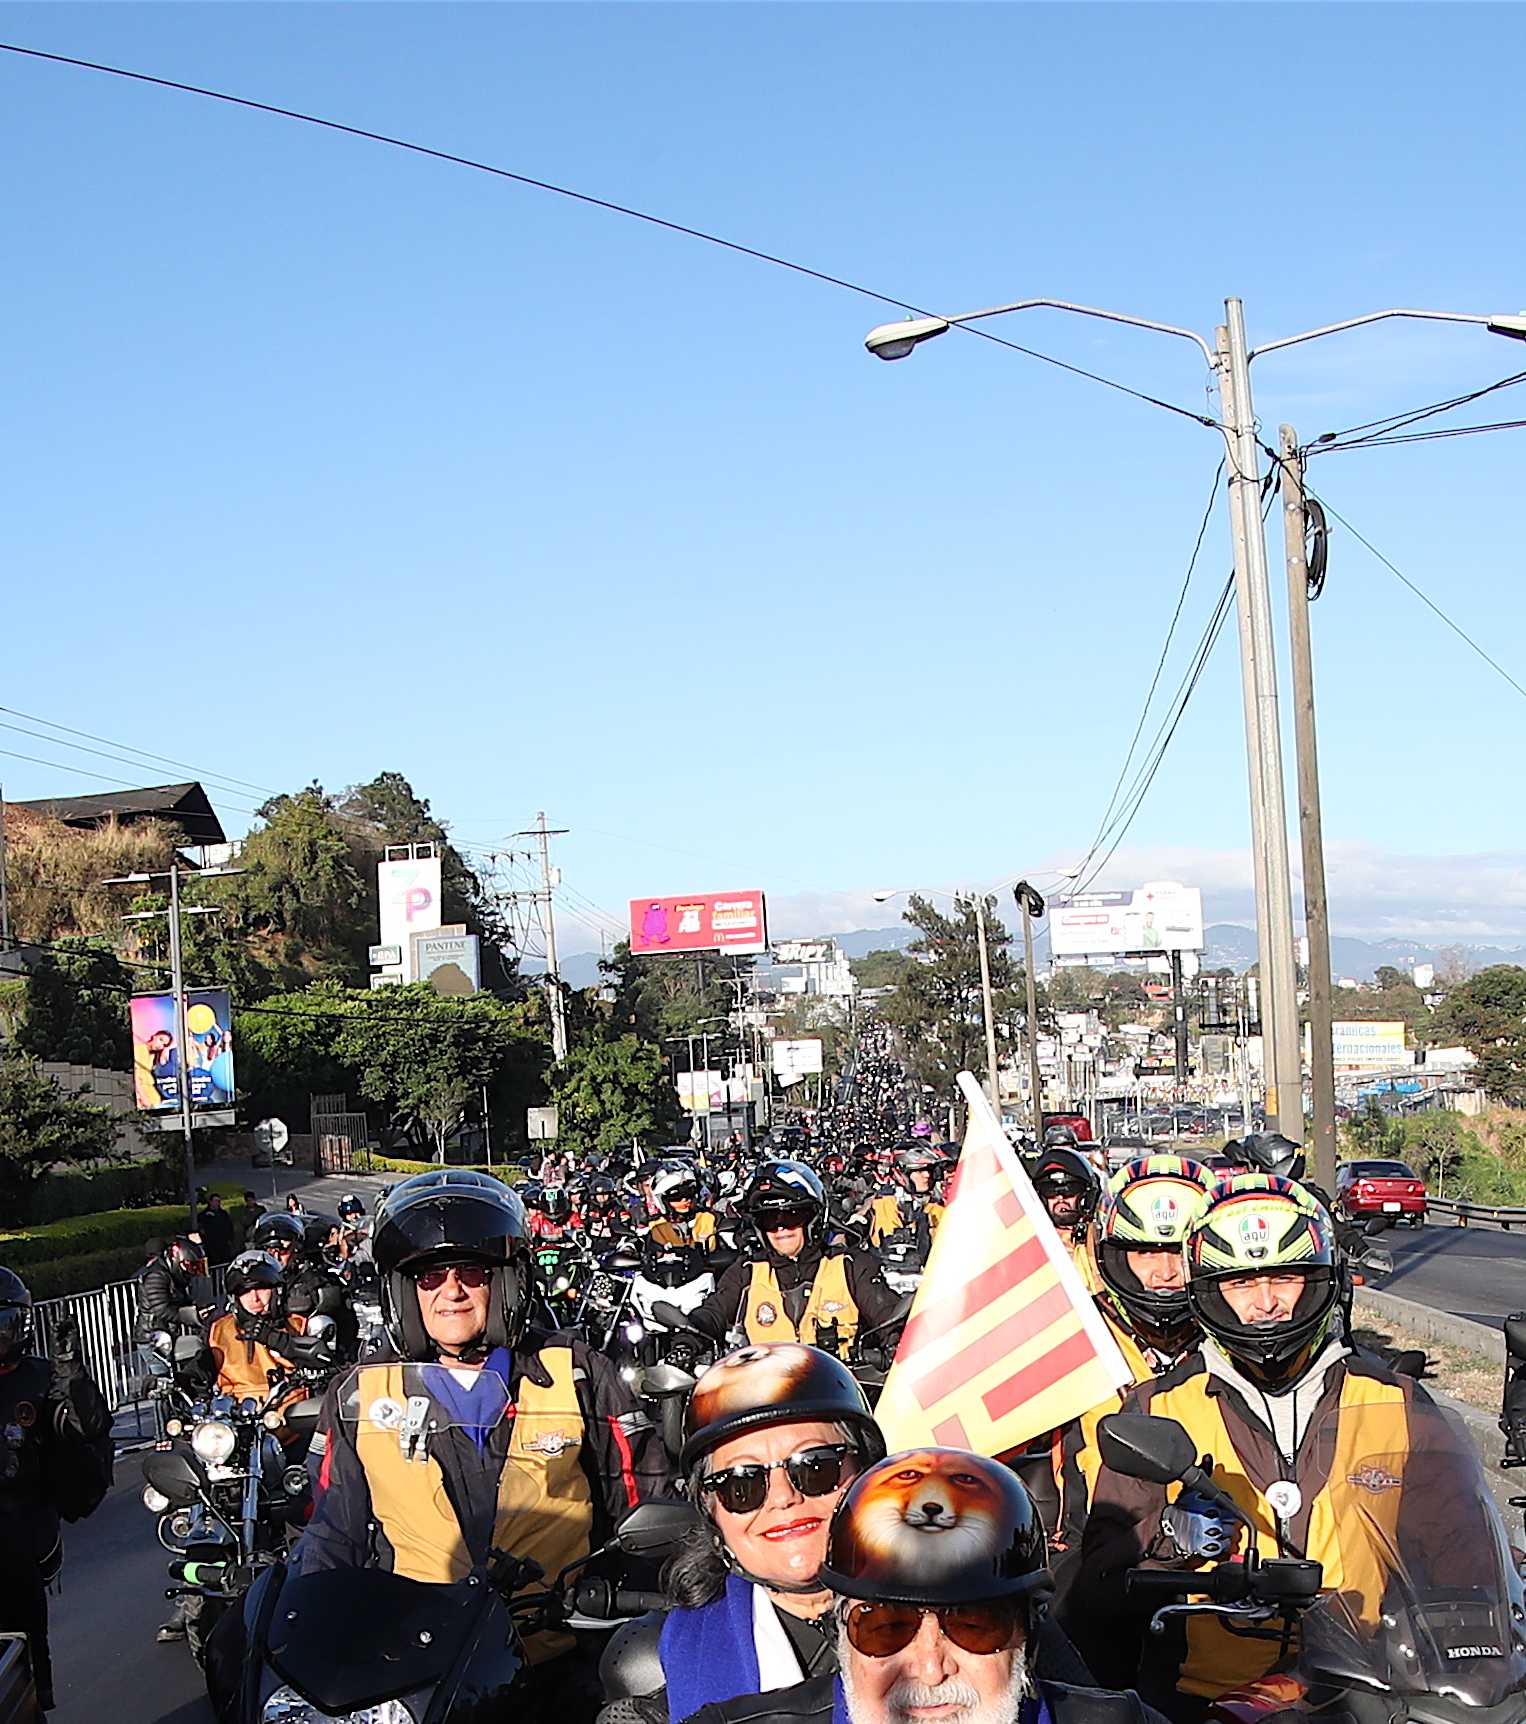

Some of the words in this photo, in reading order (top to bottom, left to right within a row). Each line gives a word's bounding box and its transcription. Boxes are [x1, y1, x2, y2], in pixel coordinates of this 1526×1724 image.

[712, 910, 755, 920] familiar
[425, 941, 466, 952] PANTENE
[1335, 1025, 1376, 1036] rámicas
[1334, 1043, 1402, 1055] ernacionales
[1447, 1646, 1502, 1659] HONDA
